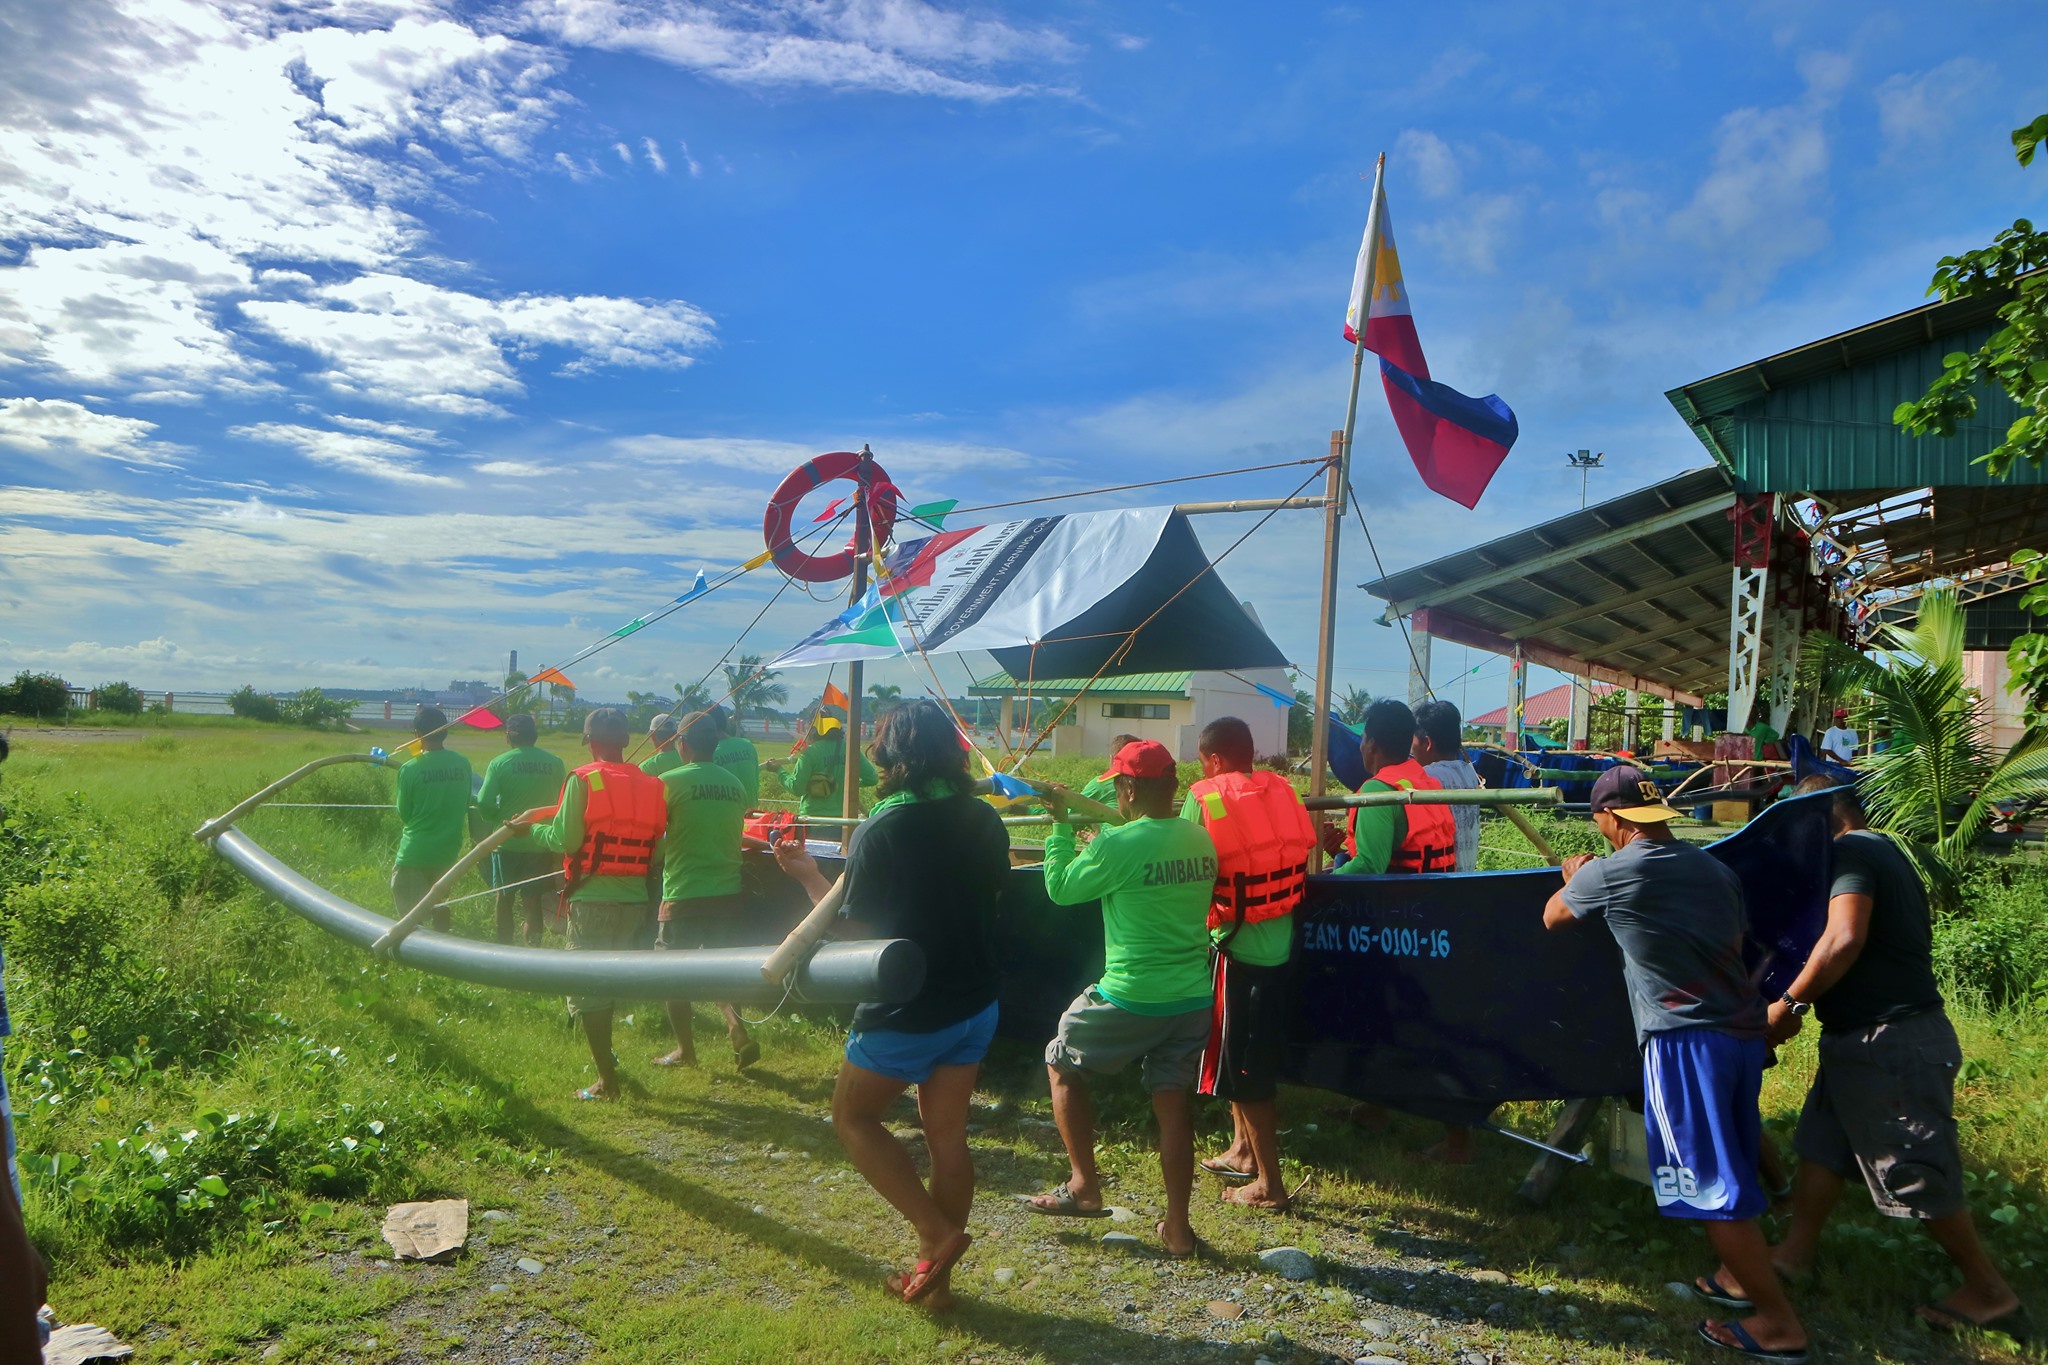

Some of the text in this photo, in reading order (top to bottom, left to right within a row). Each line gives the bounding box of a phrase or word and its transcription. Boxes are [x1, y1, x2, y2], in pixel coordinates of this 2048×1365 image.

[944, 577, 999, 637] GOVERNMENT
[421, 767, 465, 784] ZAMBALES
[1143, 856, 1218, 887] ZAMBALES
[1303, 921, 1450, 958] ZAM 05-0101-16
[1656, 1165, 1699, 1198] 26
